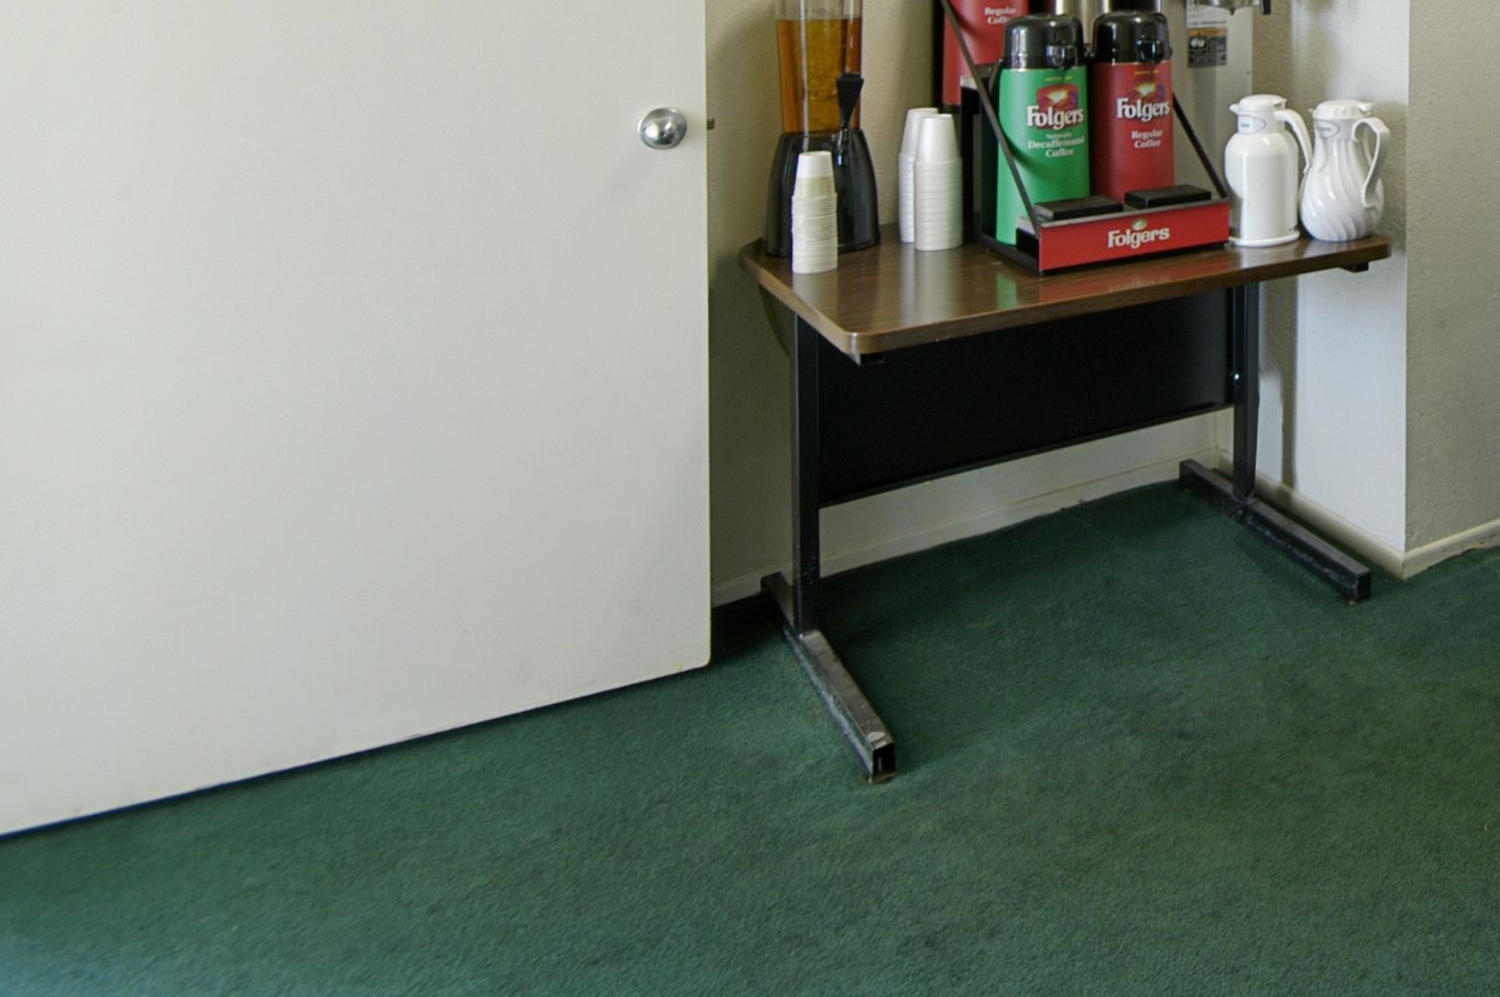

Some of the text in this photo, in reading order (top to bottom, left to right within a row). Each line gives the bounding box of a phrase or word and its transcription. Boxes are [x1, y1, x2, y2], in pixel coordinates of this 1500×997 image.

[1027, 105, 1084, 130] Folgers
[1116, 97, 1170, 122] Folgers
[1131, 129, 1163, 141] Regular
[1134, 139, 1161, 149] Coffee
[1045, 148, 1074, 158] Coffee
[1107, 226, 1170, 249] Folgers
